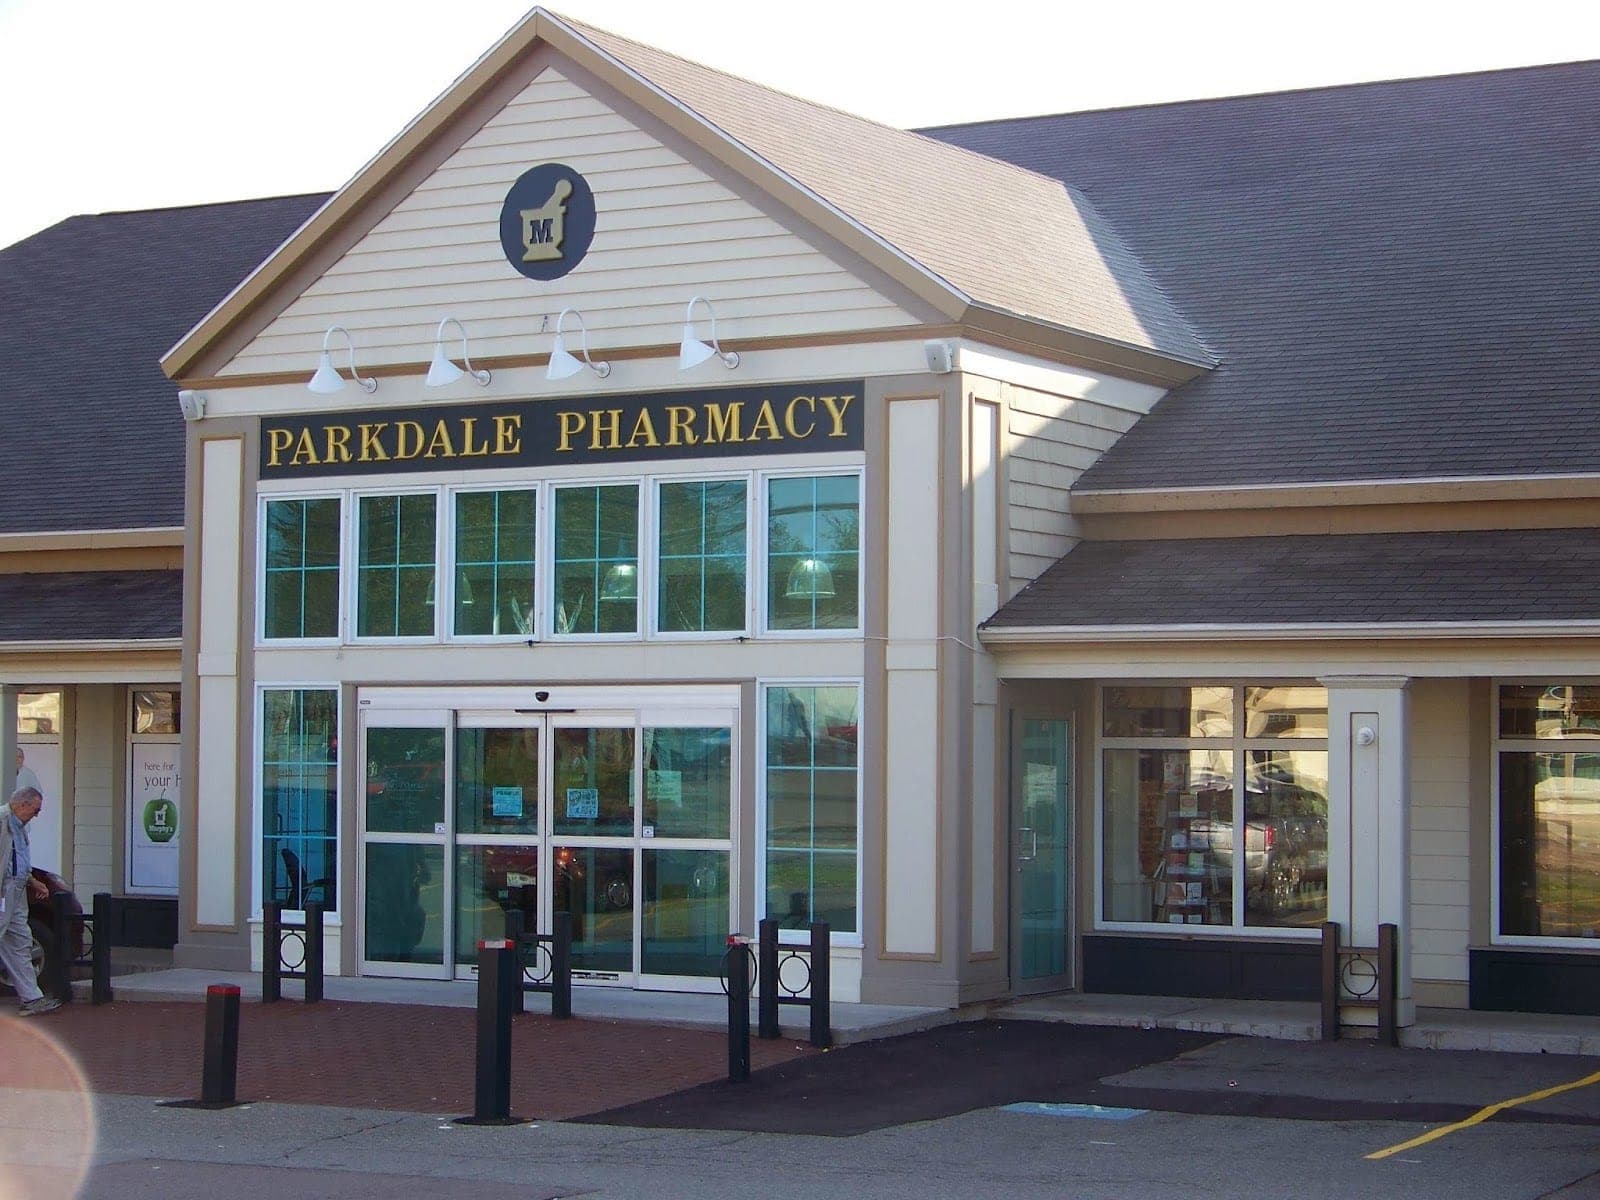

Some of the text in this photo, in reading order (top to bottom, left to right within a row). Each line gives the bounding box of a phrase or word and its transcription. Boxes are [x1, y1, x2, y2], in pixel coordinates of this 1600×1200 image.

[529, 218, 554, 245] M
[266, 394, 856, 467] PARKDALE PHARMACY
[144, 761, 175, 771] here for
[144, 777, 171, 790] your
